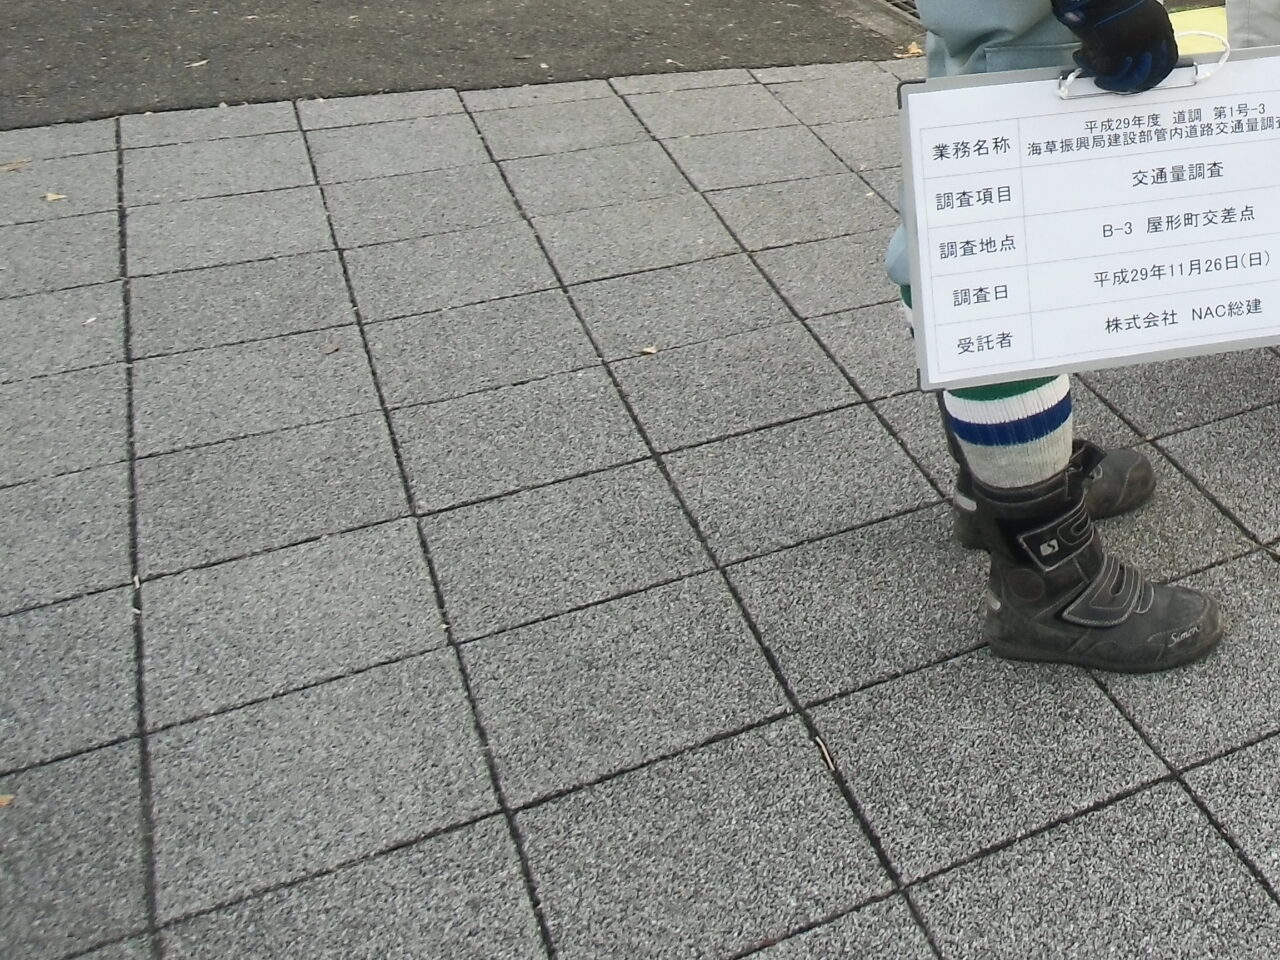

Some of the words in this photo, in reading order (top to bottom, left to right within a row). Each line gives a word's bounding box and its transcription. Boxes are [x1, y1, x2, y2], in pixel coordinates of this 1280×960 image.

[1084, 113, 1162, 134] 平成29年度
[1172, 108, 1203, 126] 道調
[1212, 102, 1267, 120] 第1号-3
[932, 136, 1011, 161] 業務名称
[1131, 161, 1224, 187] 交通量調査
[935, 185, 1012, 211] 調査項目
[1102, 221, 1133, 238] B-3
[1146, 204, 1255, 234] 屋形町交差点
[939, 234, 1016, 260] 調査地点
[1093, 250, 1270, 288] 平成29年11月26日(日)
[952, 284, 1009, 307] 調査日
[1104, 308, 1179, 334] 株式会社
[1192, 297, 1263, 321] NAC総建
[957, 331, 1013, 355] 受託者
[1169, 625, 1200, 647] Simon
